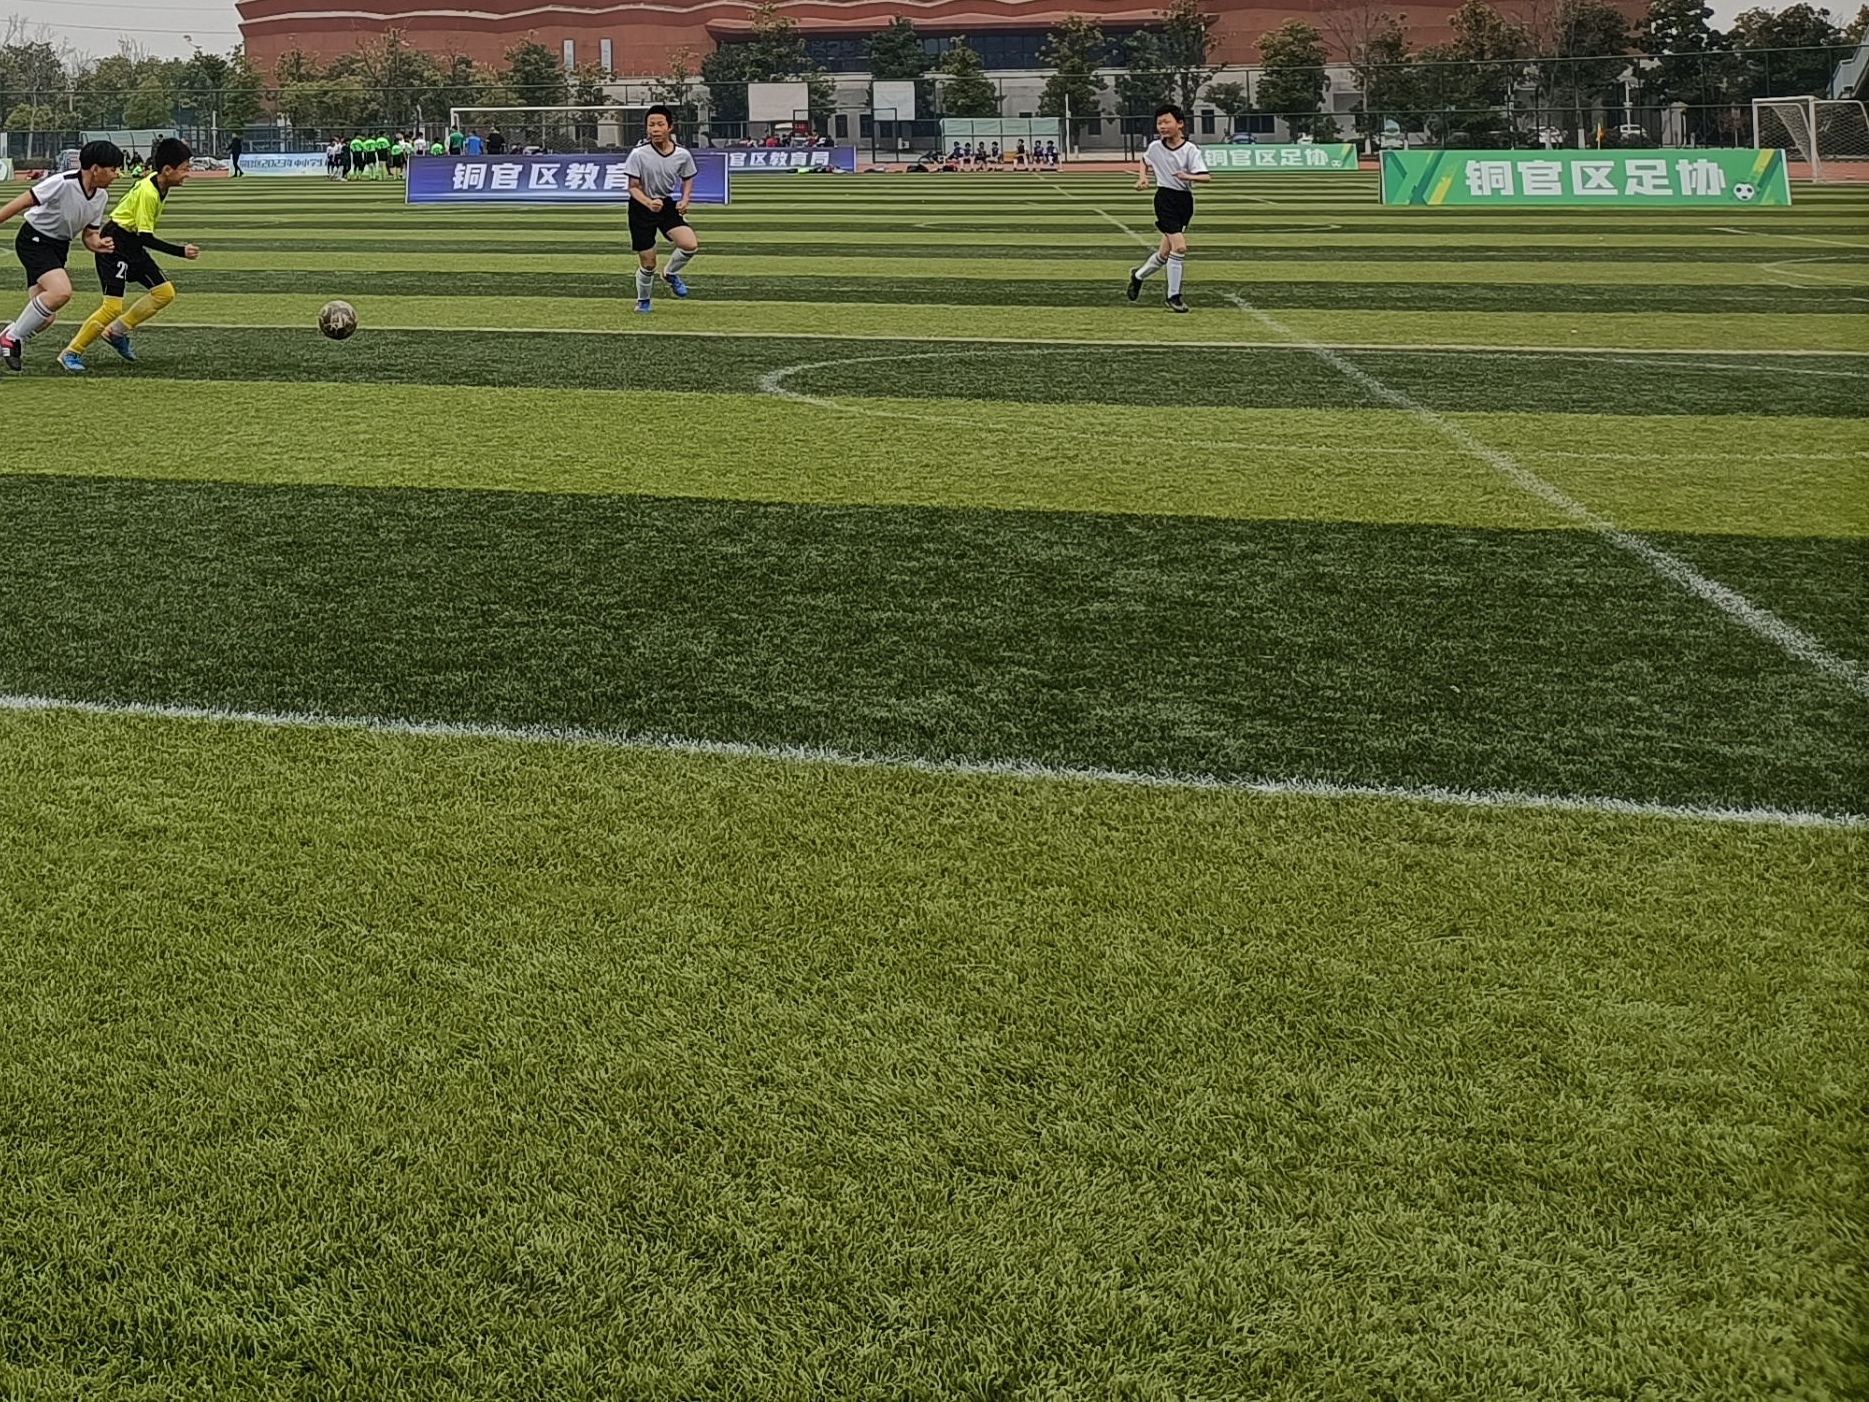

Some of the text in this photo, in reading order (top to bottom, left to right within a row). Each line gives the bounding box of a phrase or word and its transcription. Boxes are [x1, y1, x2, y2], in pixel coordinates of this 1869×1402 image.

[1204, 148, 1329, 166] 铜官区足协
[1465, 158, 1727, 197] 铜官区足协
